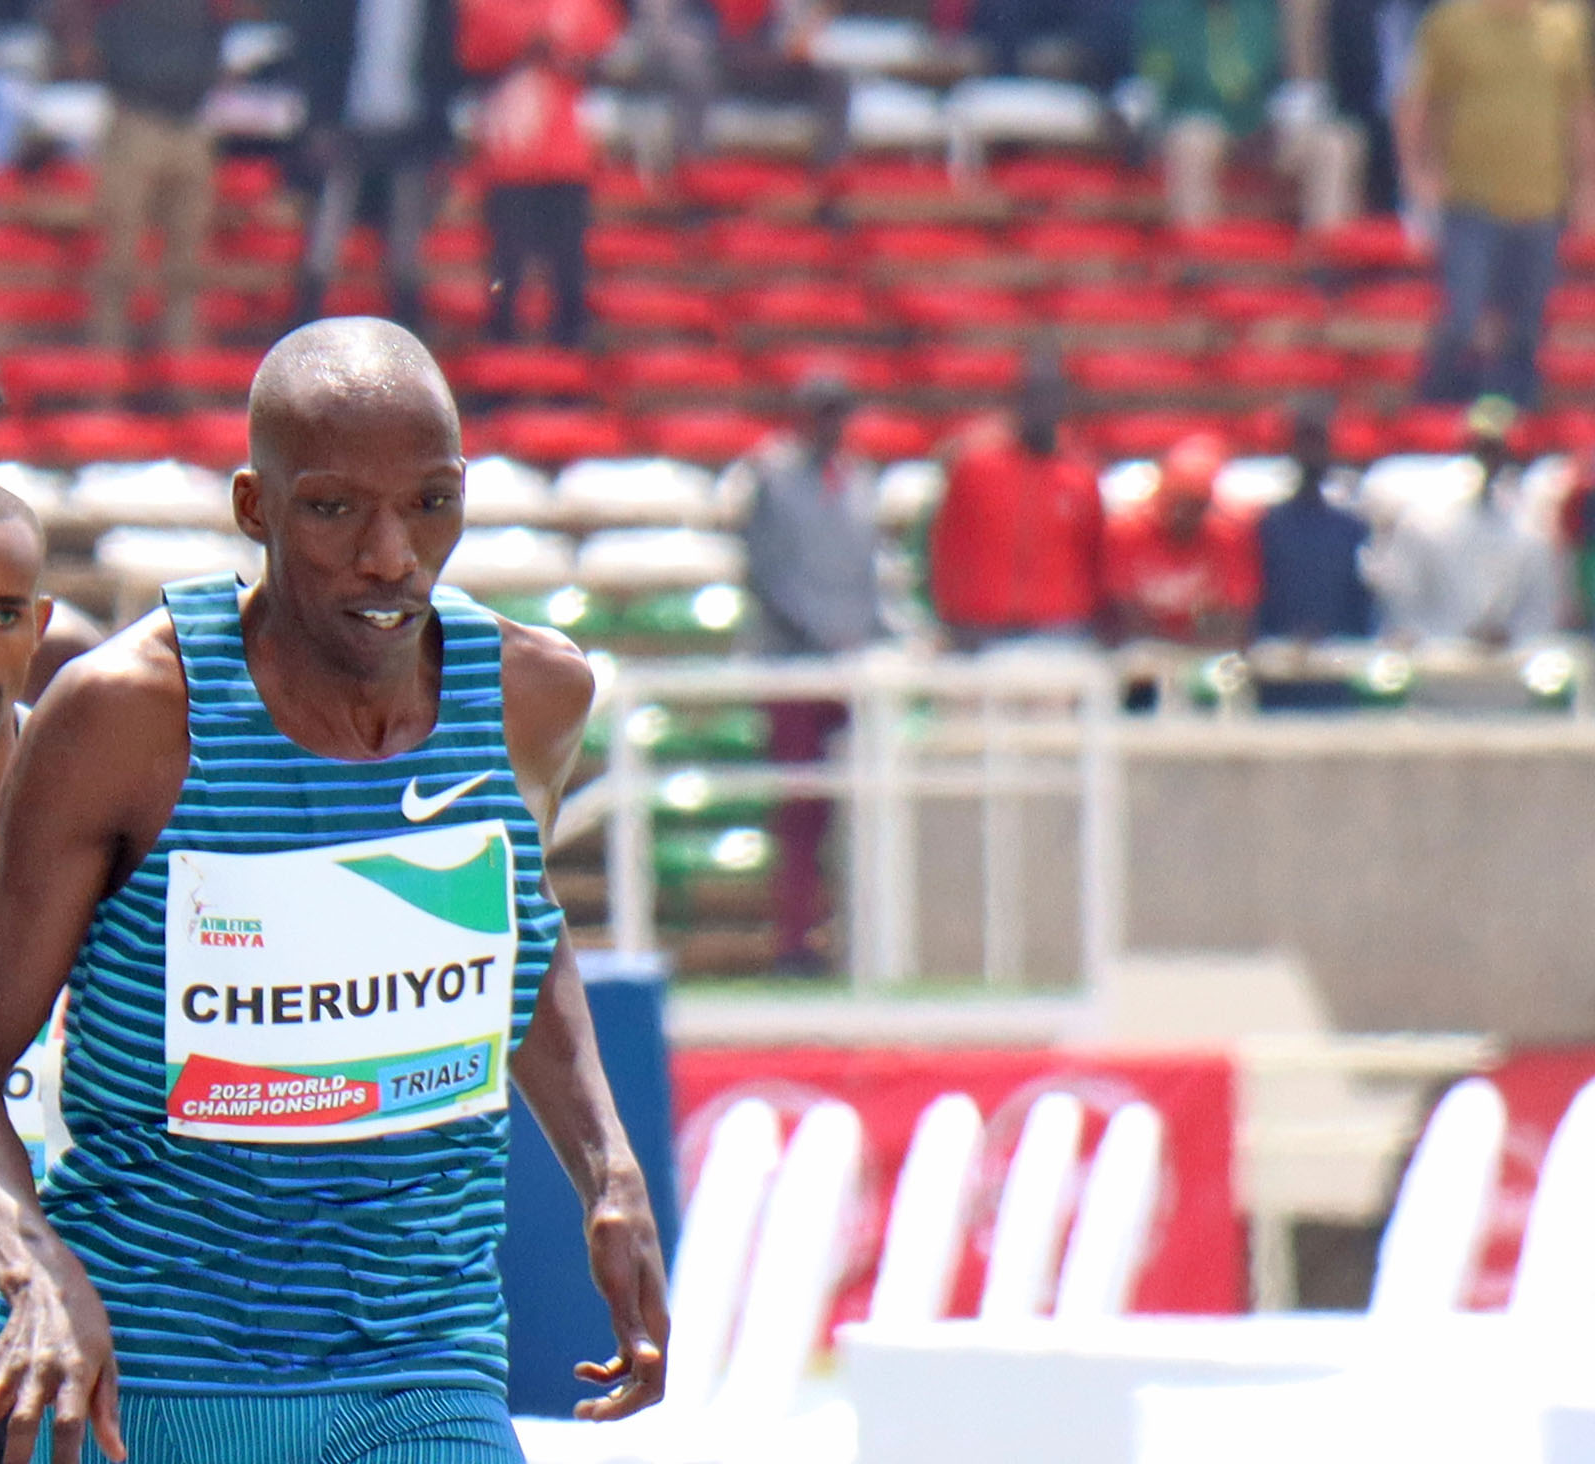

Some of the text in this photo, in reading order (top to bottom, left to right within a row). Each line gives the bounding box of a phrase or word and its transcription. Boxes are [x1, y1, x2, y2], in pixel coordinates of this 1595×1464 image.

[200, 931, 264, 948] KENYA
[181, 956, 496, 1026] CHERUIYOT
[209, 1074, 347, 1101] 2022 WORLD
[390, 1053, 480, 1101] TRIALS
[182, 1087, 368, 1118] CHAMPIONSHIPS
